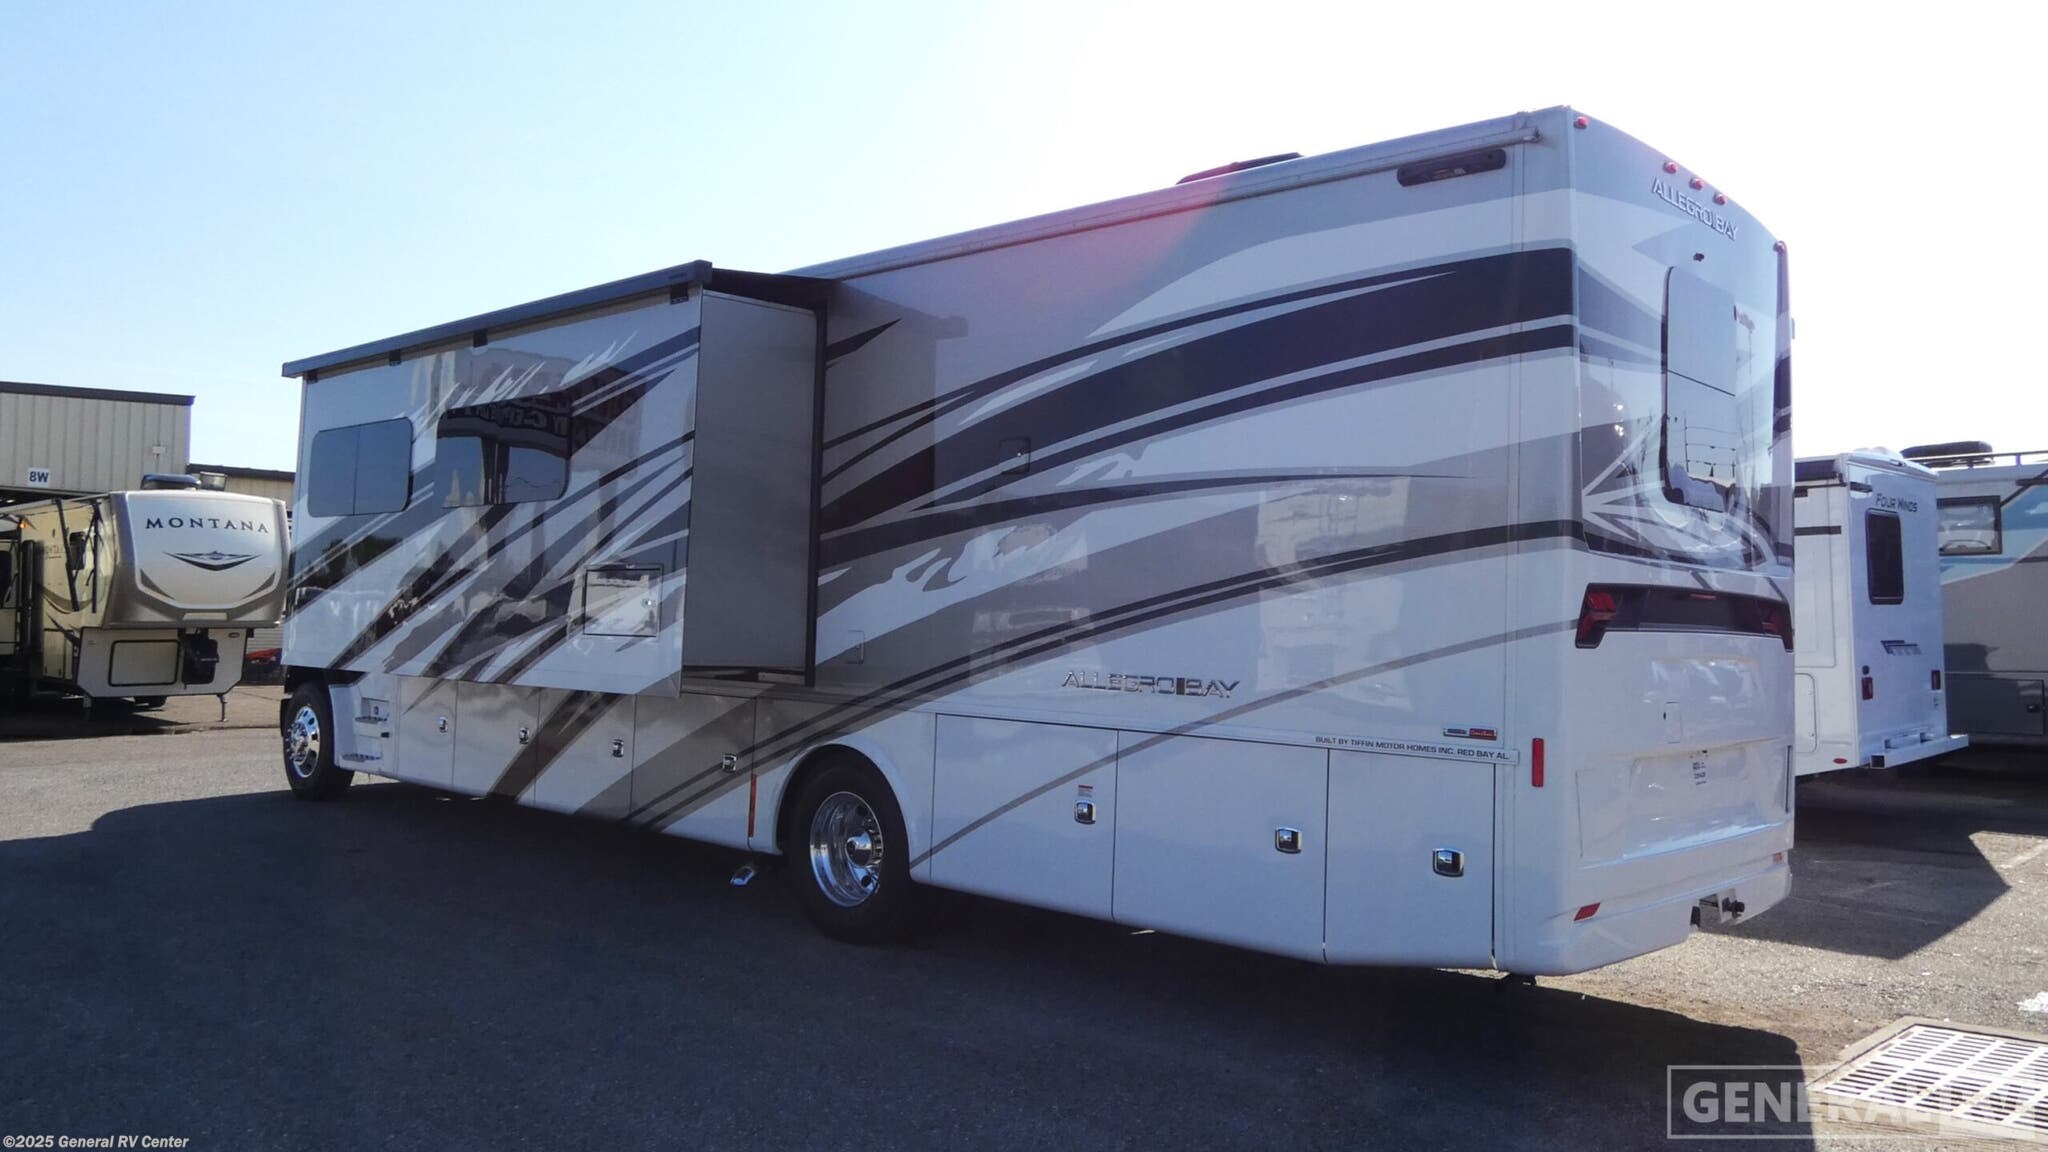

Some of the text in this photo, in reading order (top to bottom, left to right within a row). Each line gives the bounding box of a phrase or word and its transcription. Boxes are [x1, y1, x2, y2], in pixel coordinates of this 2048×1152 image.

[1651, 177, 1738, 241] ALLEGRO BAY
[29, 471, 49, 483] 8W
[145, 517, 269, 534] MONTANA
[1062, 671, 1240, 698] ALLEGRO BAY
[1315, 735, 1336, 745] BUILT
[1351, 738, 1374, 748] TIFFIN
[1375, 741, 1405, 751] MOTOR
[1406, 744, 1437, 753] HOMES
[1438, 747, 1454, 755] INC.
[1457, 748, 1475, 757] RED
[1476, 750, 1495, 759] BAY
